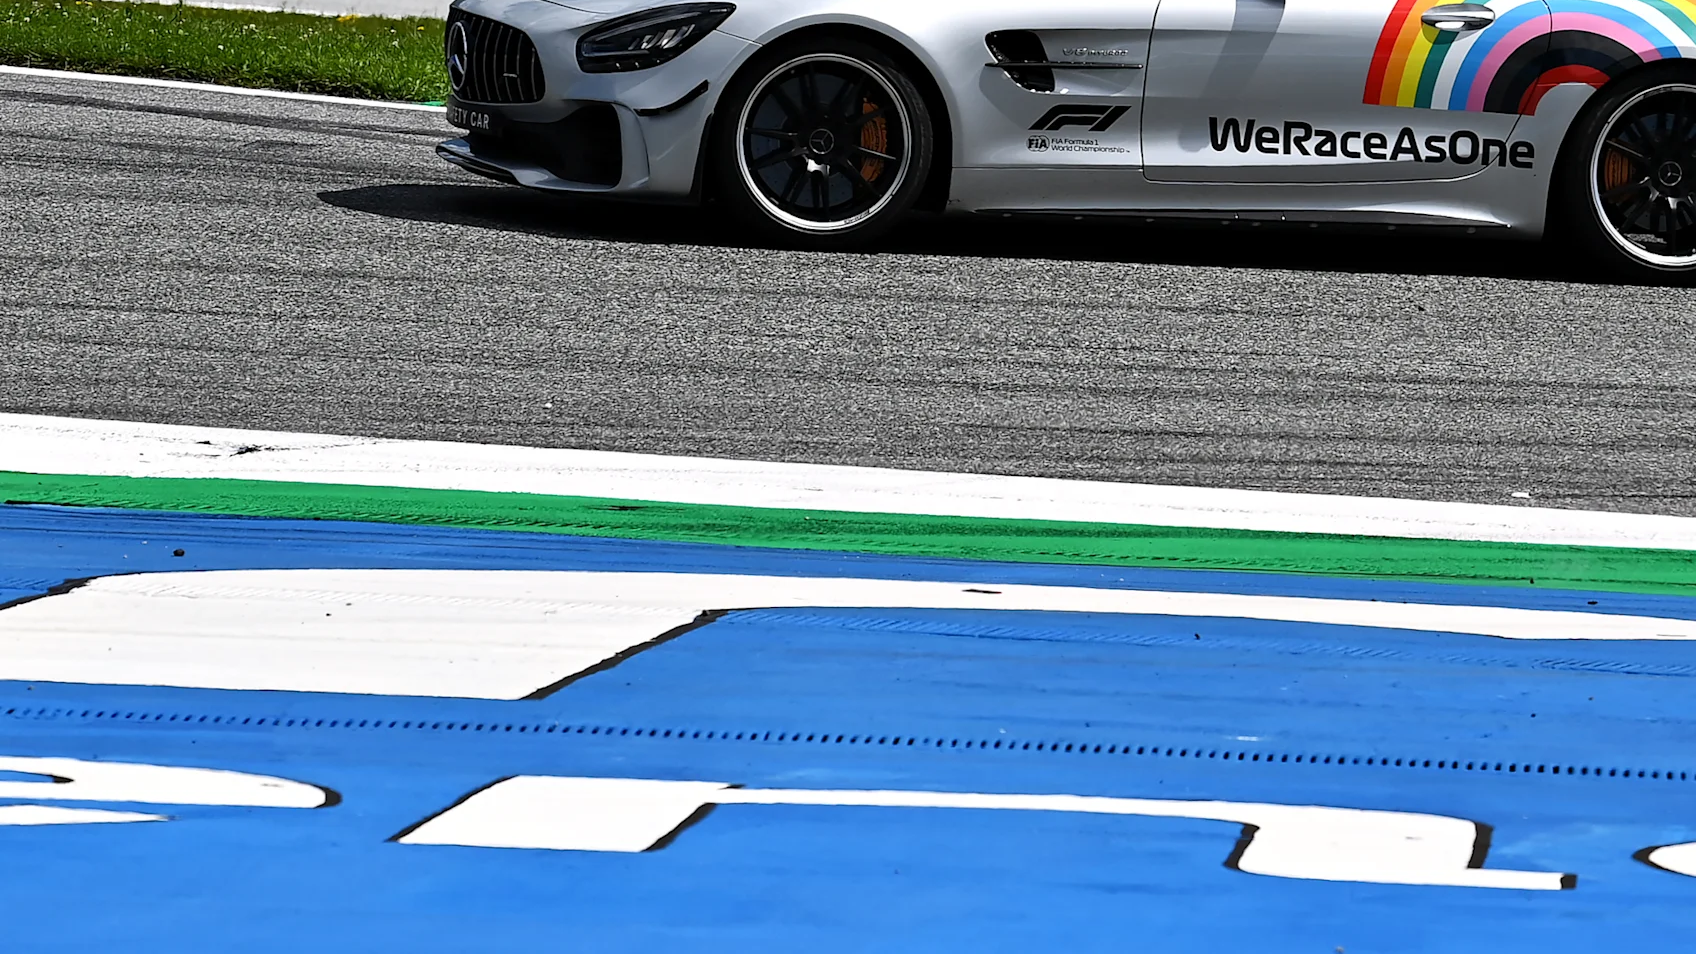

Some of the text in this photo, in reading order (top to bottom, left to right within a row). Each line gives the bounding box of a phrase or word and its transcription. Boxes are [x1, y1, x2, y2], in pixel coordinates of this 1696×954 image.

[452, 106, 490, 130] ETY CAR
[1052, 138, 1063, 146] FIA
[1064, 138, 1094, 146] Formula
[1074, 146, 1125, 154] Championship
[1208, 116, 1535, 169] WeRaceAsOne
